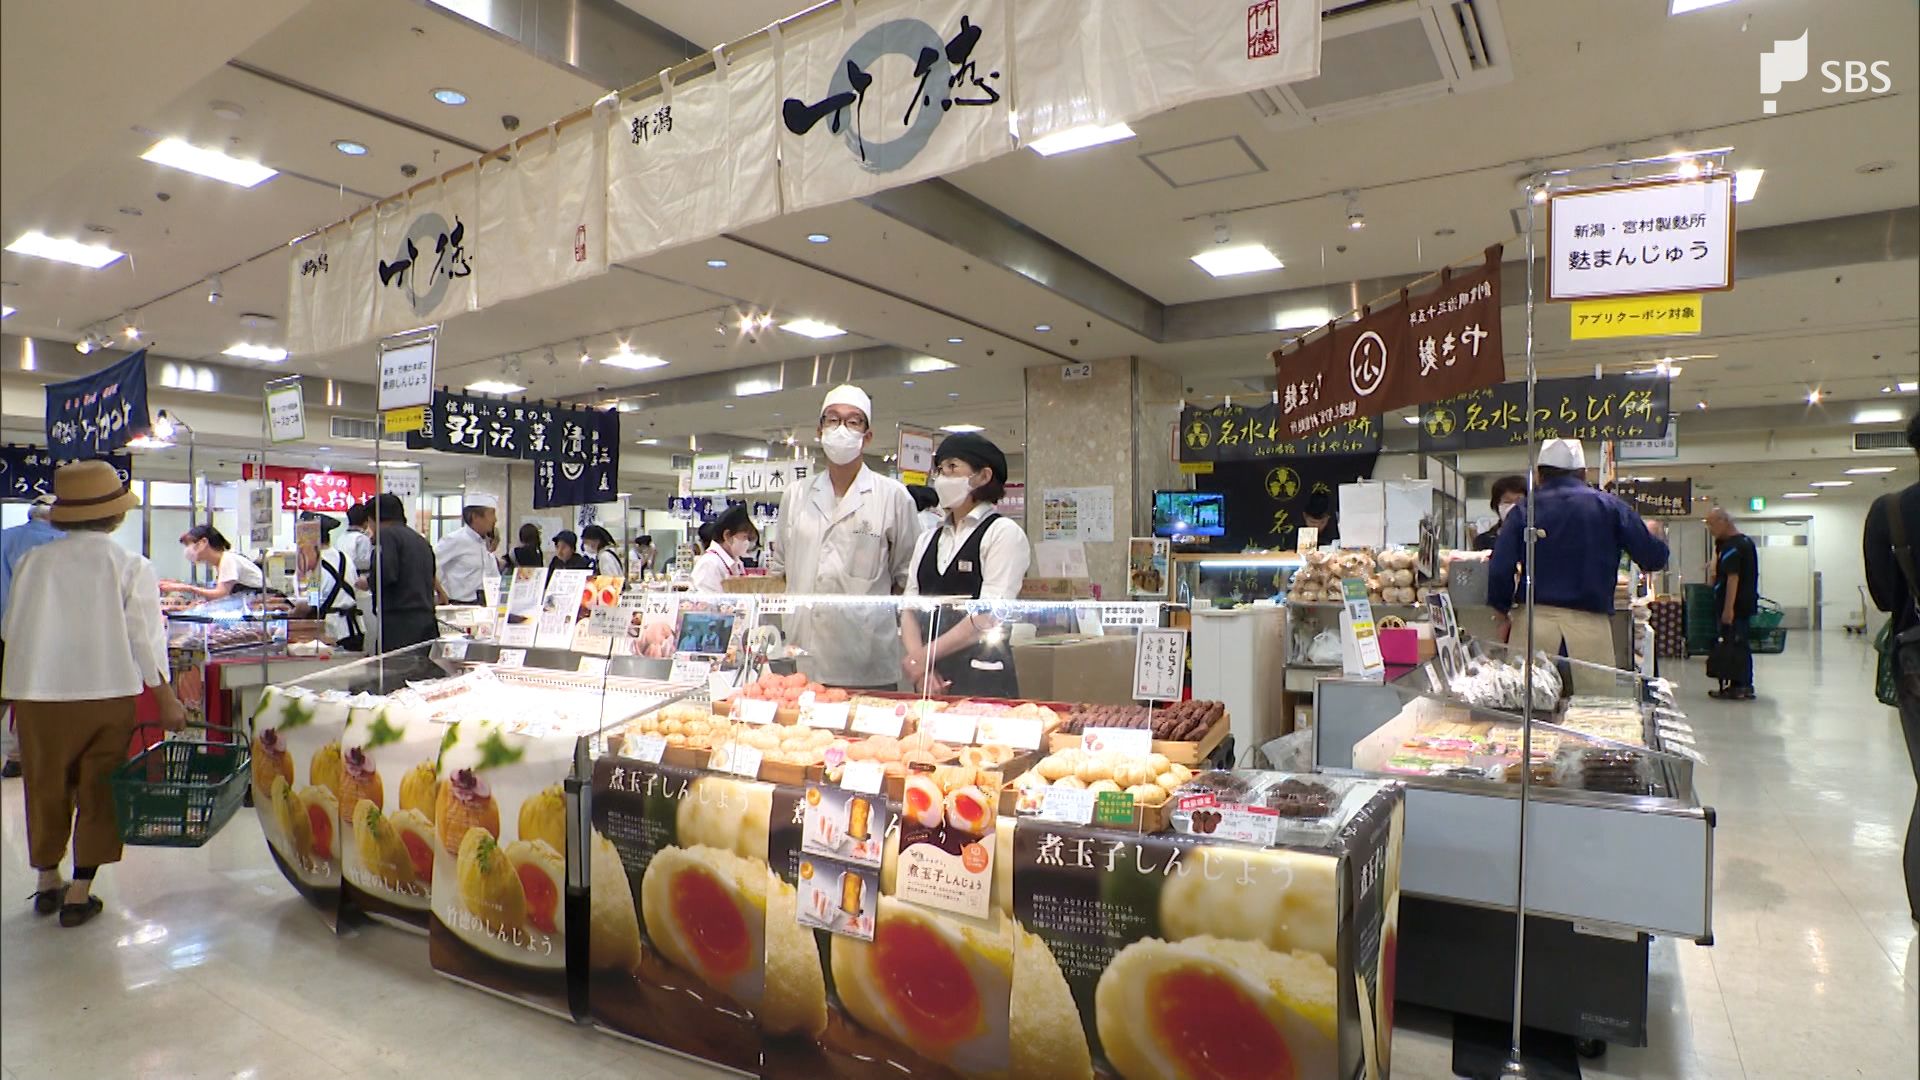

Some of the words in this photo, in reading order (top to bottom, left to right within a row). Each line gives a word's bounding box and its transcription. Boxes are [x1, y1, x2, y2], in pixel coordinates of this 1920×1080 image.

[631, 105, 673, 145] 新潟
[1573, 212, 1707, 239] 新潟・宮村製麩所
[1568, 240, 1709, 272] 麩まんじゅう
[1578, 307, 1696, 326] アプリクーポン対象
[445, 415, 588, 460] 野沢菜漬
[609, 766, 750, 814] 煮玉子しんじょう
[907, 862, 983, 891] 煮玉子しんじょう
[1035, 832, 1295, 891] 煮玉子しんじょう
[446, 905, 553, 957] 竹徳のしんじょう
